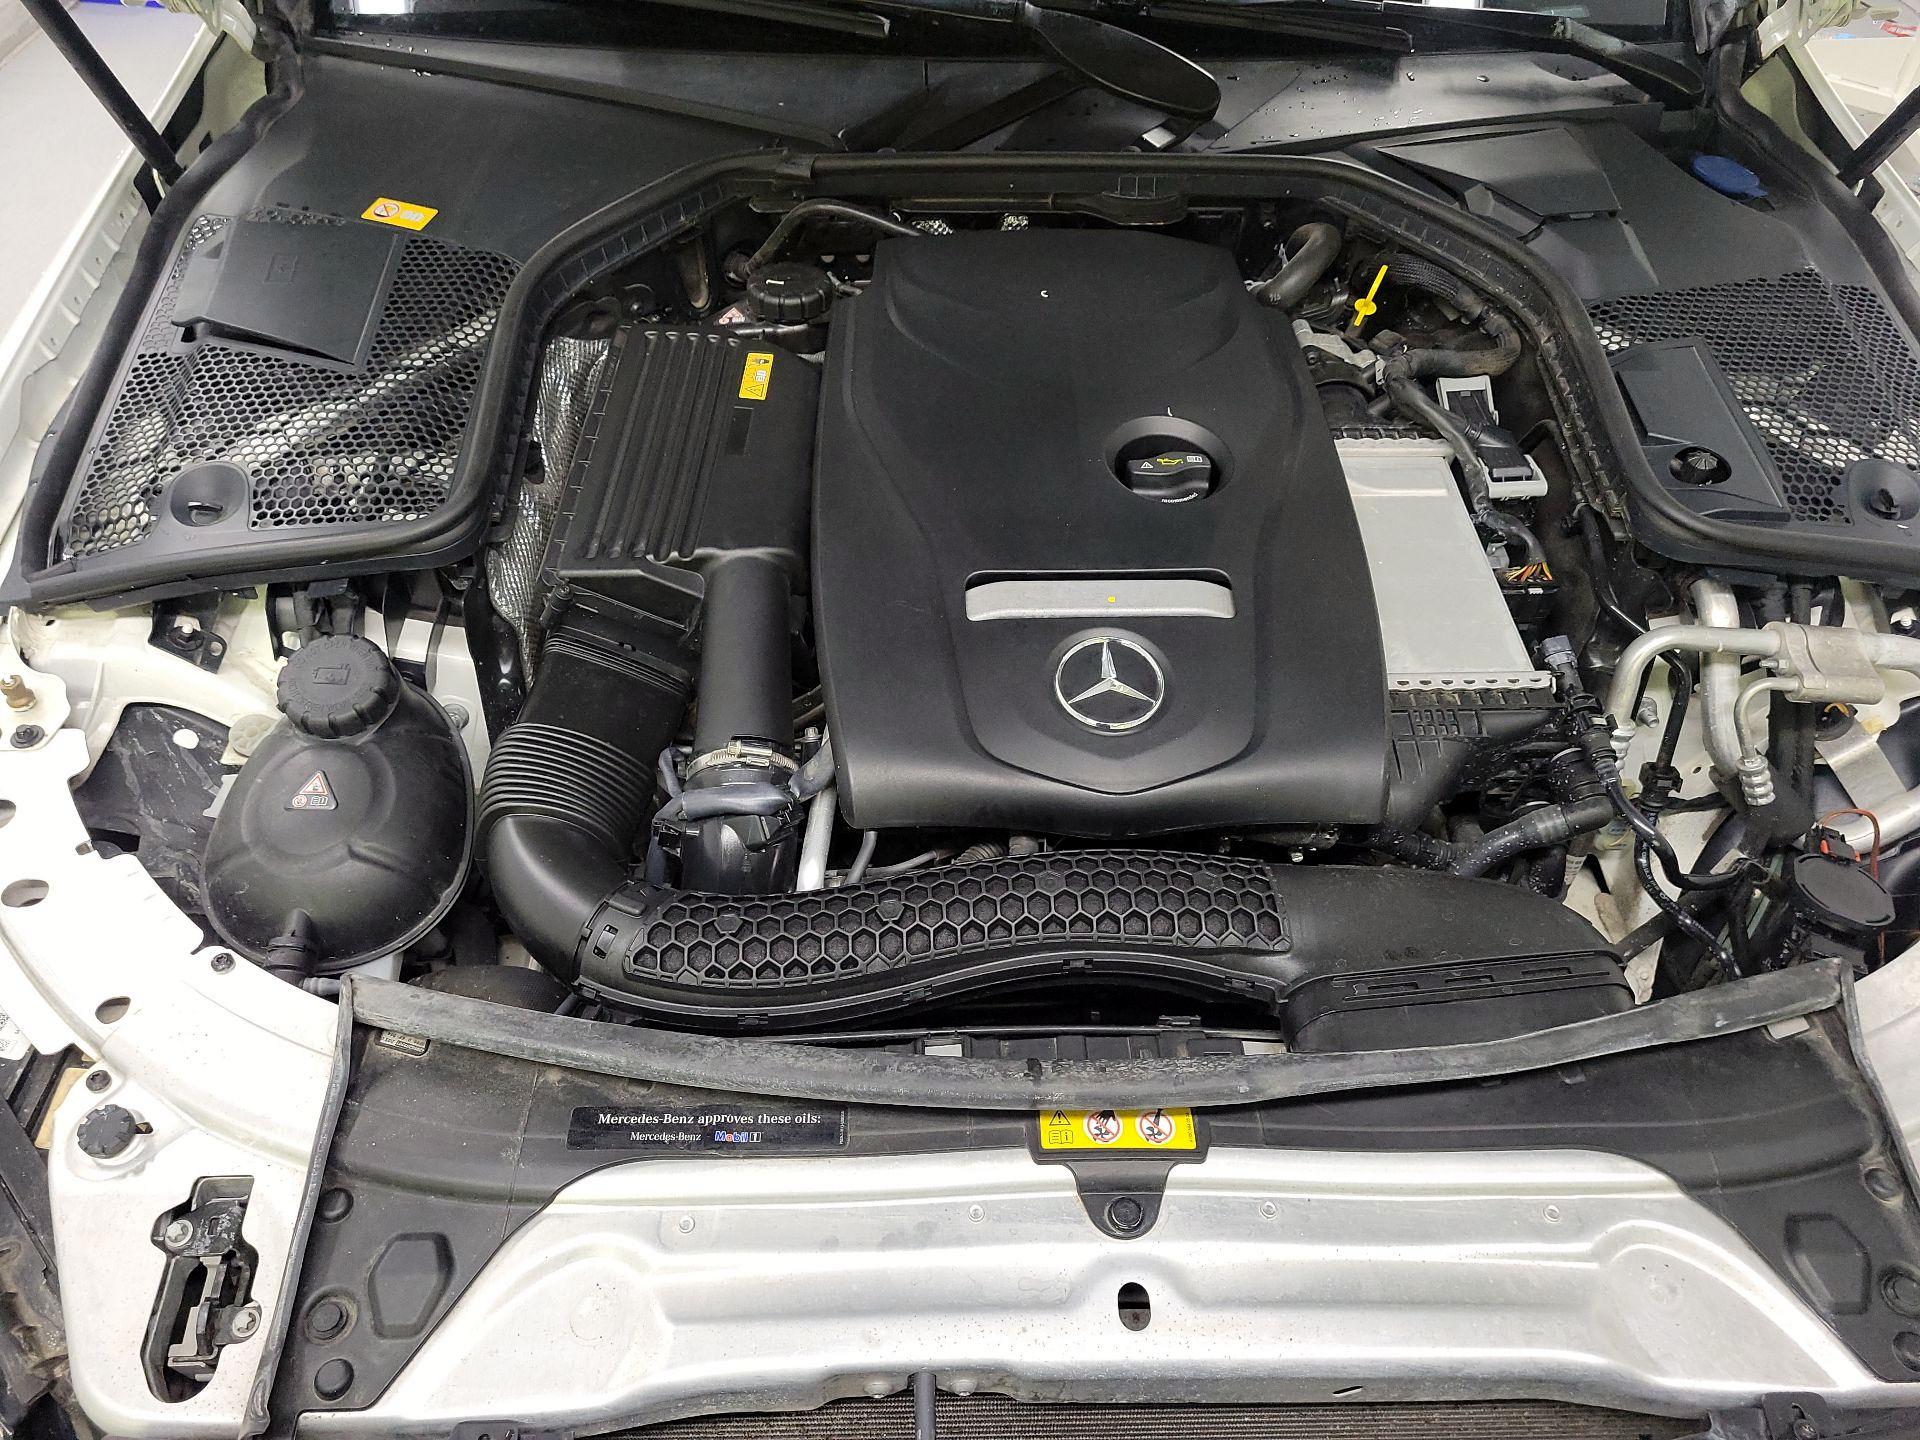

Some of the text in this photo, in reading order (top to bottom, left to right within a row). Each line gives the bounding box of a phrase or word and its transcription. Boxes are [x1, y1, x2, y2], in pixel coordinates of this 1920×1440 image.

[598, 1112, 821, 1126] Mercedes-Benz approves these oils:
[630, 1131, 702, 1141] Mercedes-Benz
[715, 1131, 749, 1142] Mobil
